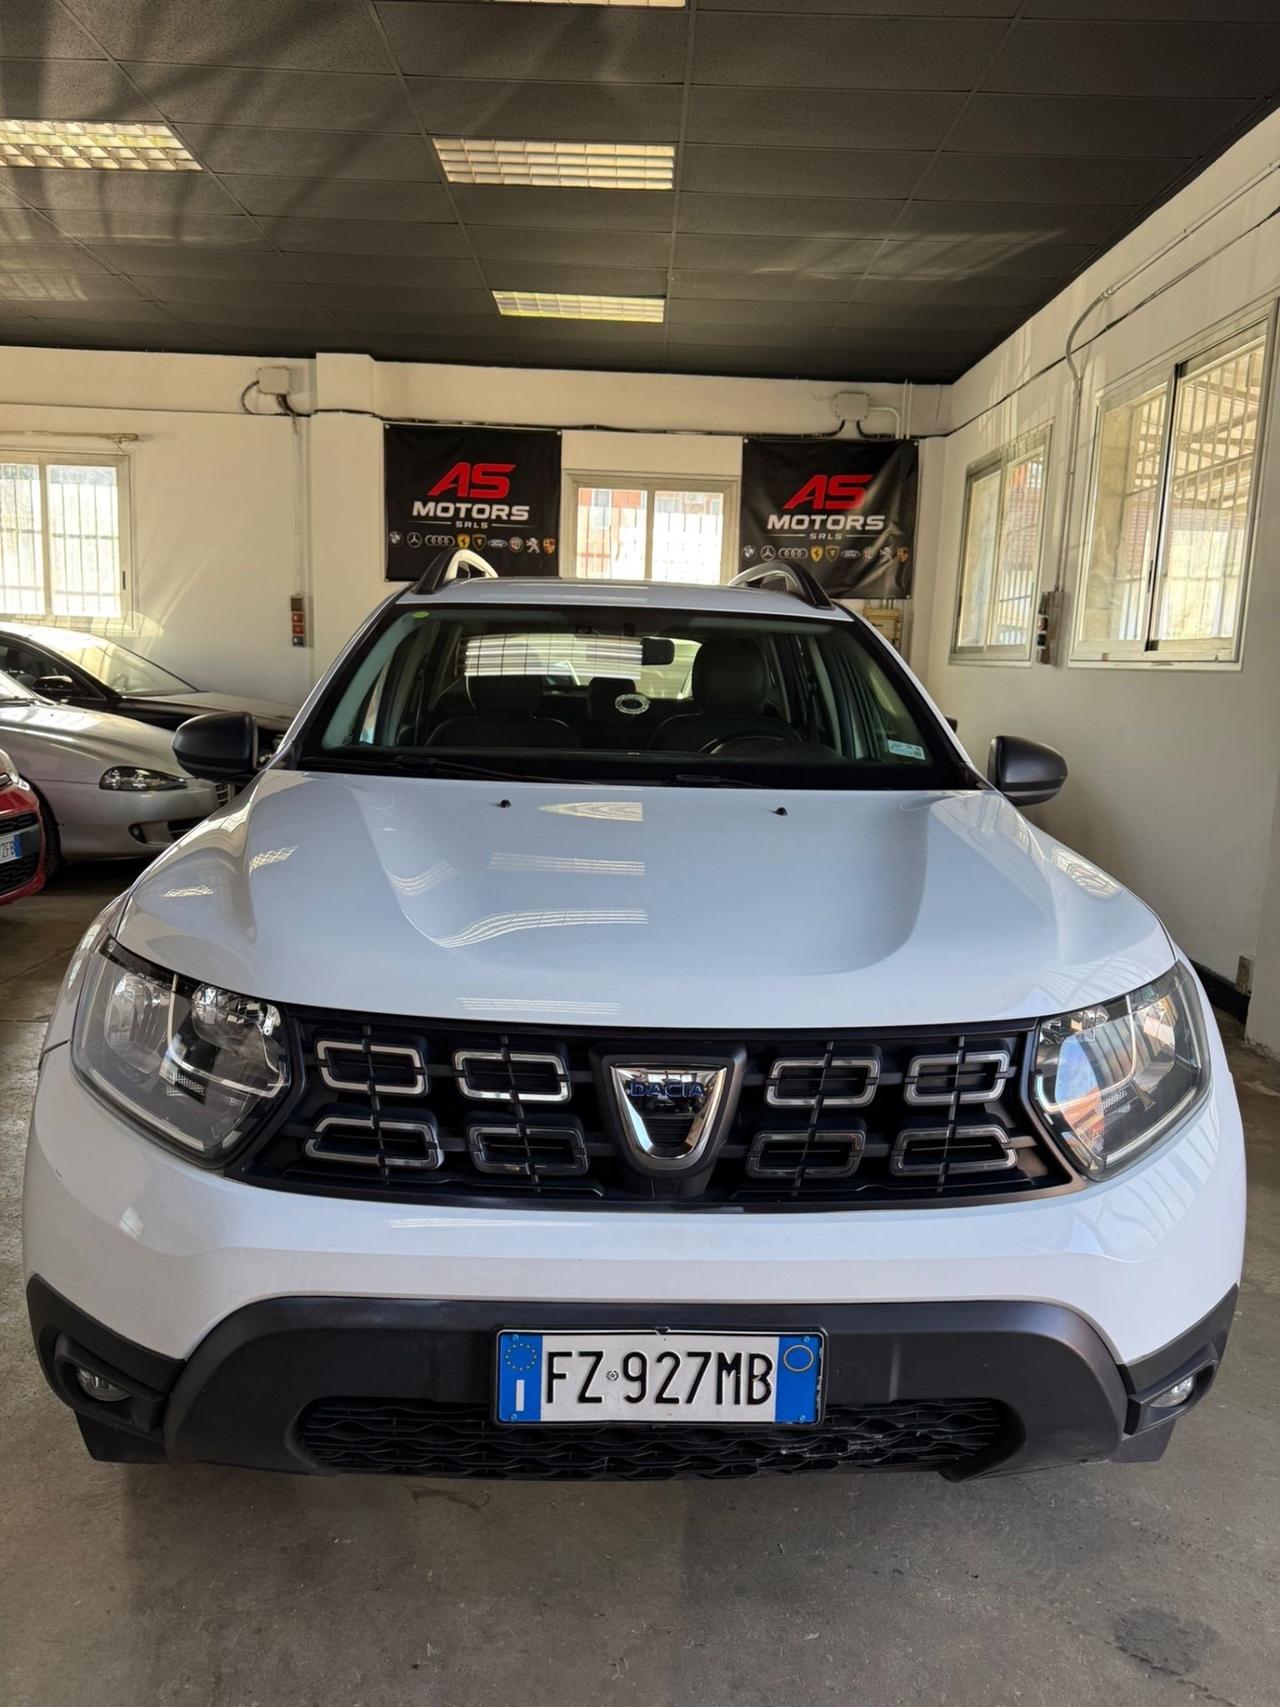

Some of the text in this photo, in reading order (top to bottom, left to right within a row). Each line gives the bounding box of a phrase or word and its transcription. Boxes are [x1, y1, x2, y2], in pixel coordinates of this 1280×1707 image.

[427, 462, 516, 499] AS
[783, 474, 873, 510] AS
[412, 501, 530, 520] MOTORS
[456, 521, 489, 529] SRLS
[766, 514, 885, 531] MOTORS
[629, 1081, 705, 1098] DACIA
